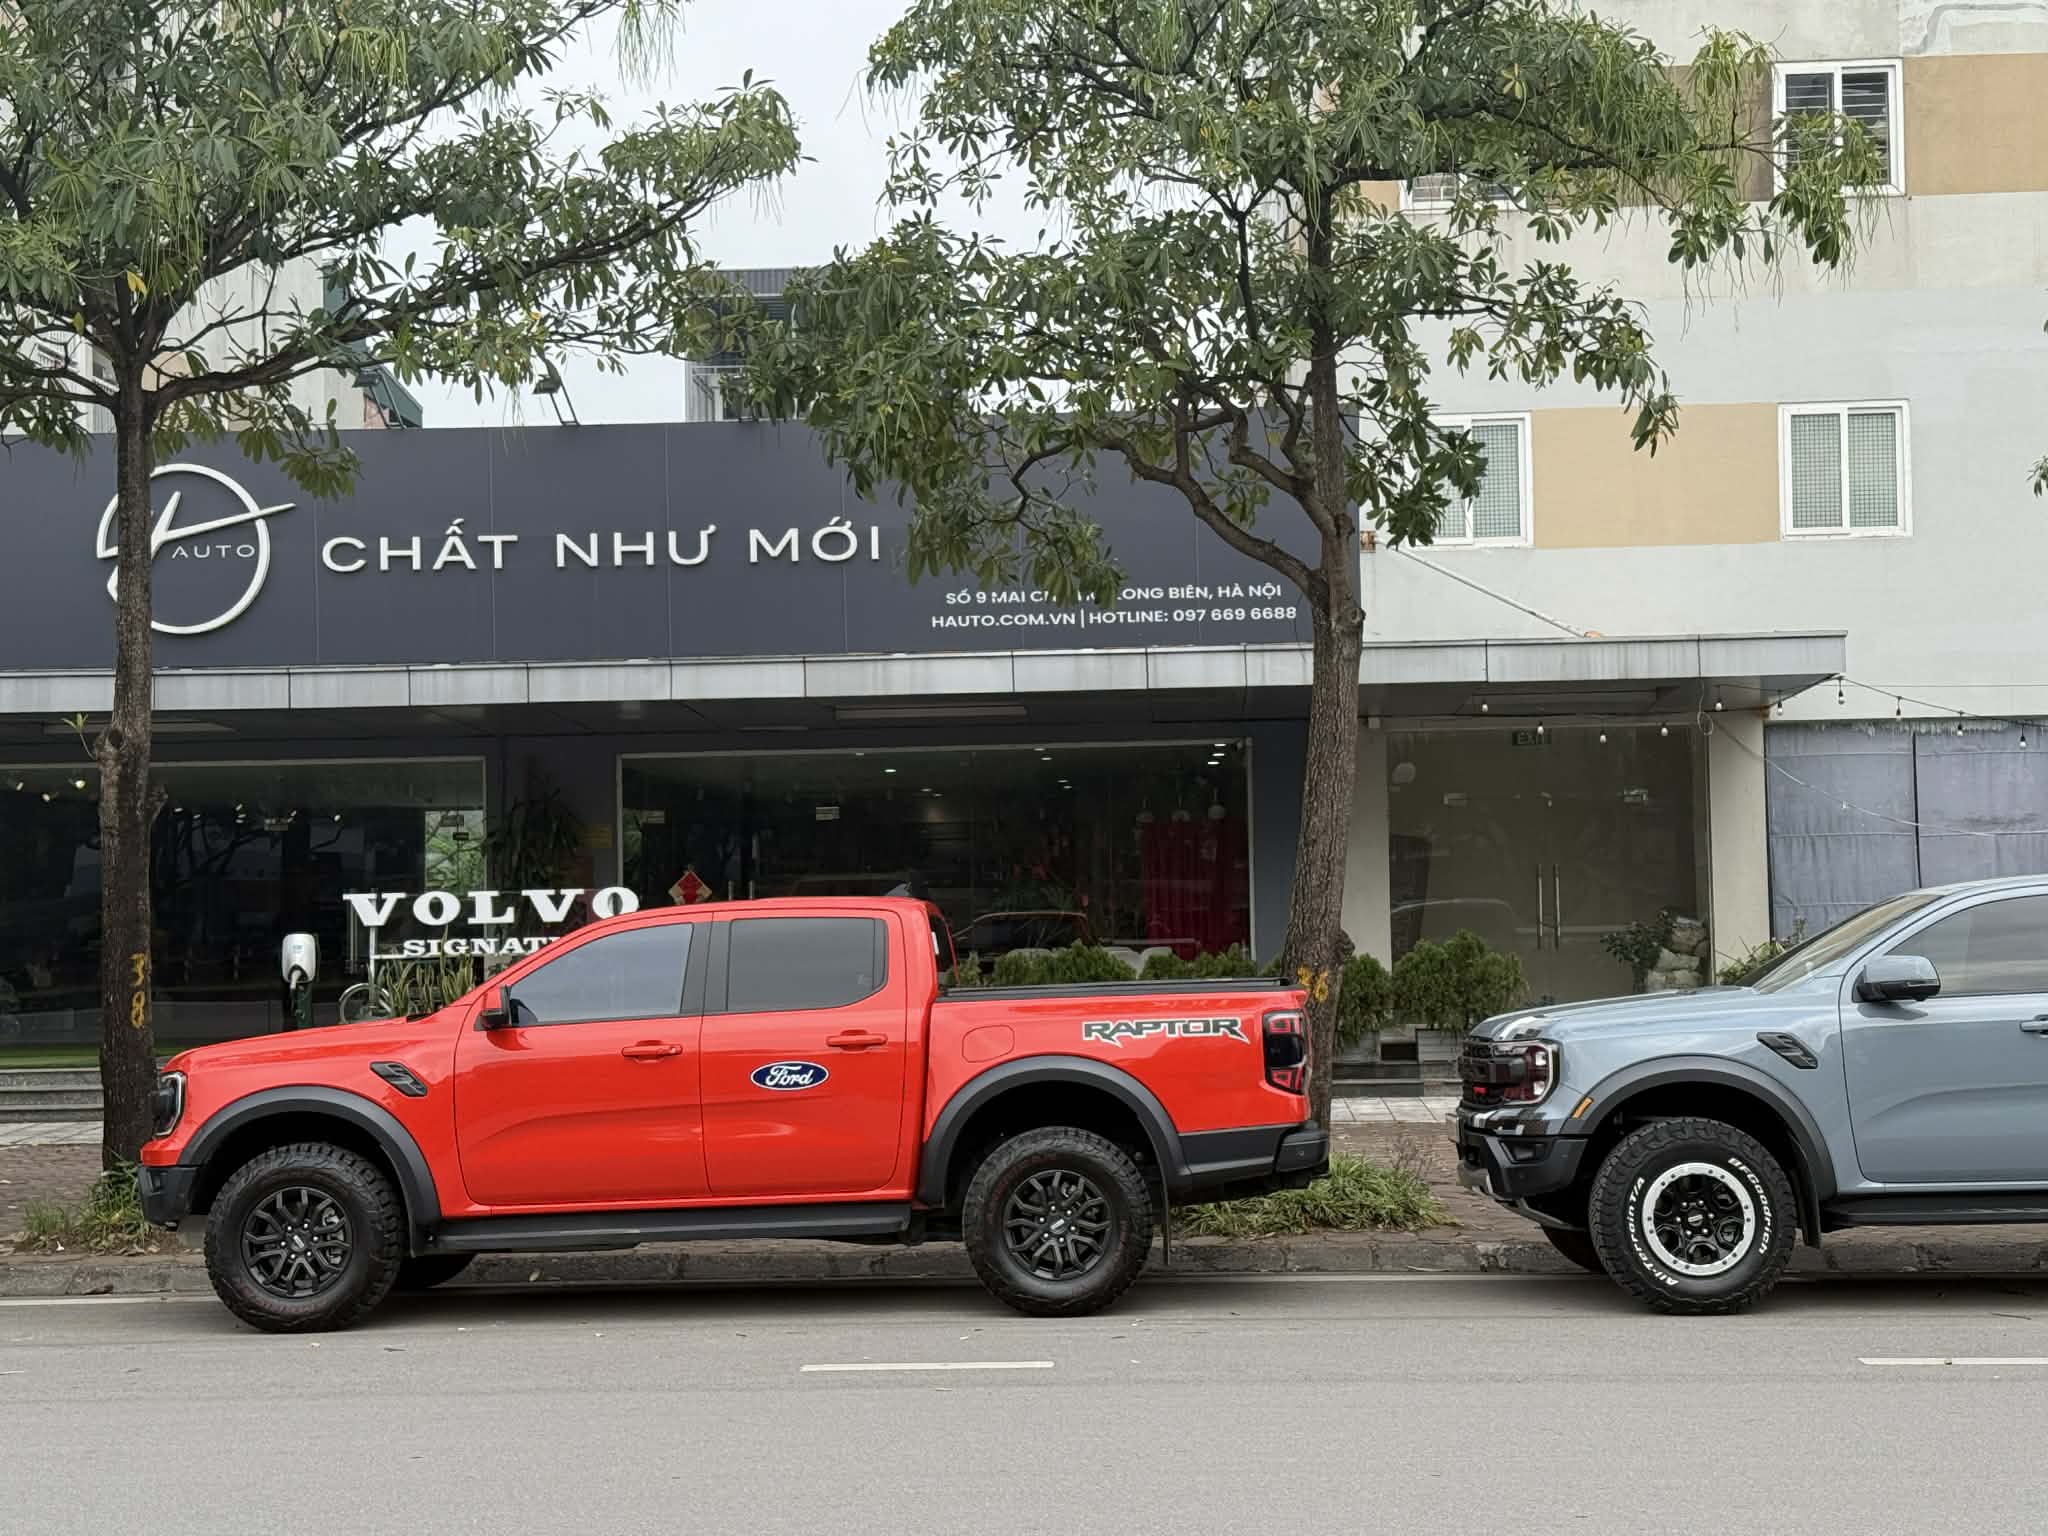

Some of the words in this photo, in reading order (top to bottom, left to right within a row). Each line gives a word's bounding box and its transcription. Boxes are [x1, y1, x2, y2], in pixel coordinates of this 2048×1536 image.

[172, 544, 255, 559] AUTO
[322, 518, 518, 572] CHẤT
[556, 524, 716, 567] NHƯ
[750, 516, 879, 563] MỚI
[945, 588, 972, 605] SỐ
[976, 591, 986, 604] 9
[991, 591, 1025, 604] MAI
[1117, 587, 1164, 601] ONG
[1168, 585, 1213, 600] BIÊN,
[1218, 583, 1244, 598] HÀ
[1249, 582, 1282, 600] NỘI
[931, 612, 1076, 628] HAUTO.COM.VN
[1089, 609, 1169, 624] HOTLINE:
[1173, 609, 1206, 622] 097
[1211, 608, 1246, 621] 669
[1250, 606, 1297, 620] 6688
[343, 887, 639, 926] VOLVO
[1082, 1018, 1251, 1048] RAPTOR
